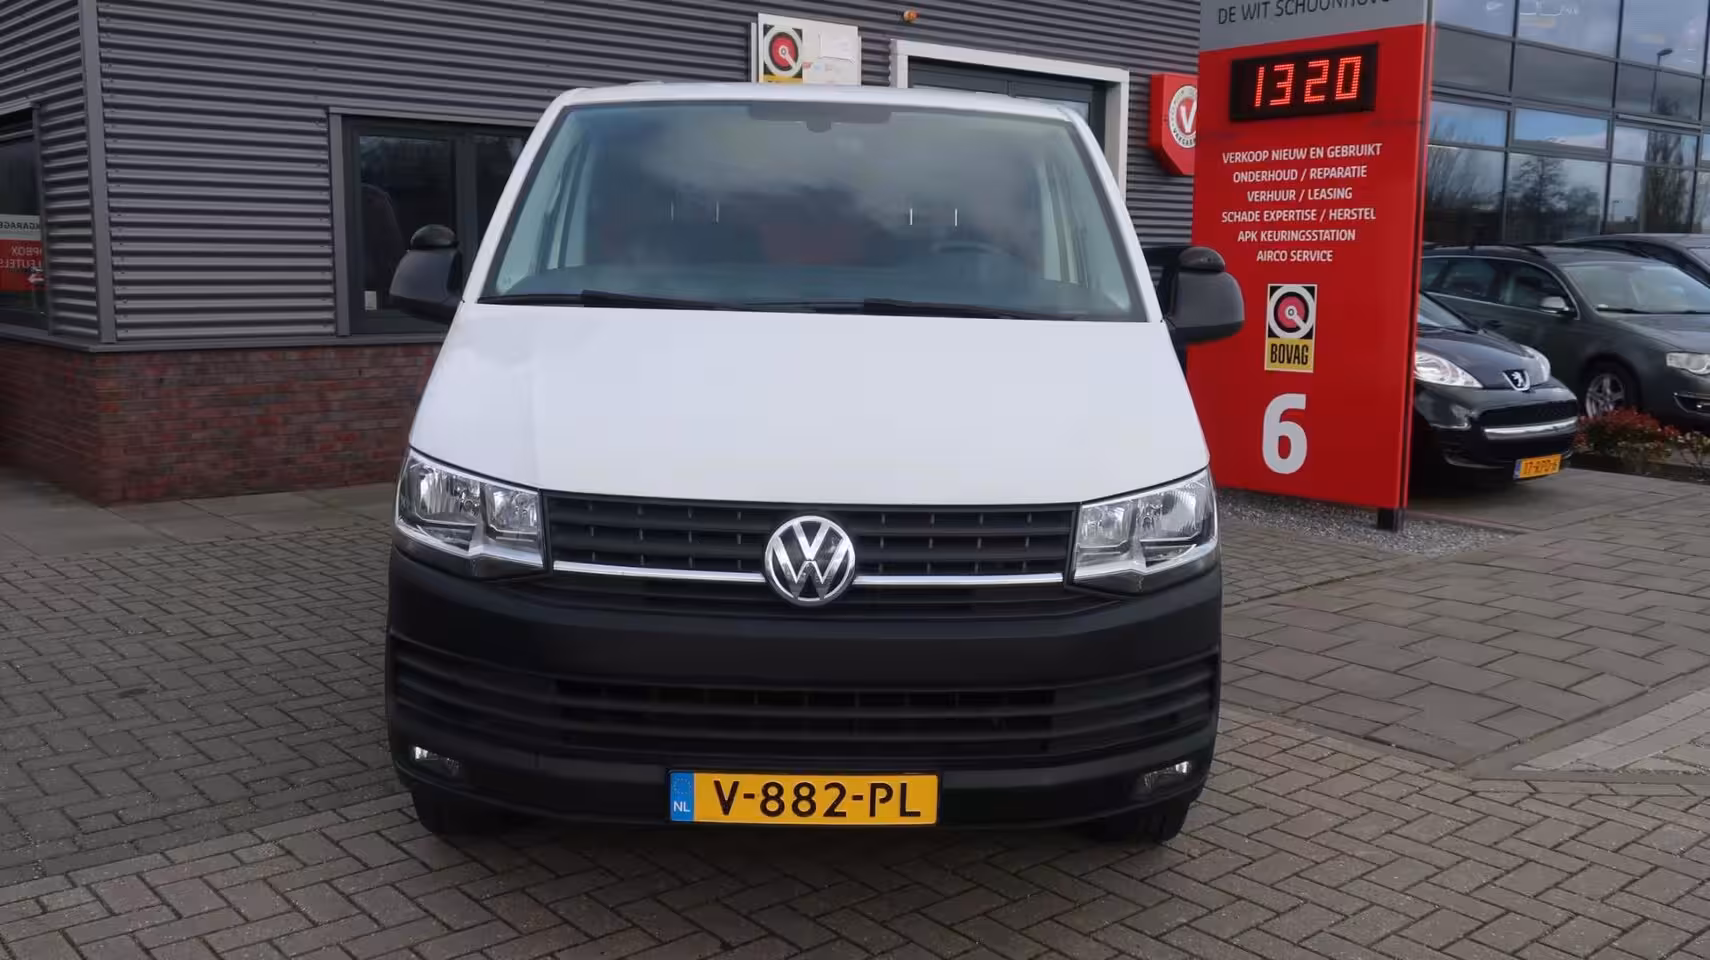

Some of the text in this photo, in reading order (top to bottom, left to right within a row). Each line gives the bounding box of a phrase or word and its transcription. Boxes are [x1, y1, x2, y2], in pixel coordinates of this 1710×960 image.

[1218, 0, 1389, 24] DE WIT SCHOO
[1223, 143, 1382, 163] VERKOOP NIEUW EN GEBRUIKT
[1233, 166, 1367, 183] ONDERHOUD / REPARATIE
[1247, 187, 1352, 202] VERHUUR / LEASING
[1222, 208, 1375, 223] SCHADE EXPERTISE / HERSTEL
[1238, 229, 1355, 242] APK KEURINGSSTATION
[1257, 250, 1332, 261] AIRCO SERVICE
[1270, 343, 1309, 365] BOVAG
[1262, 393, 1307, 474] 6
[673, 801, 690, 812] NL
[713, 780, 921, 818] V-882-PL
